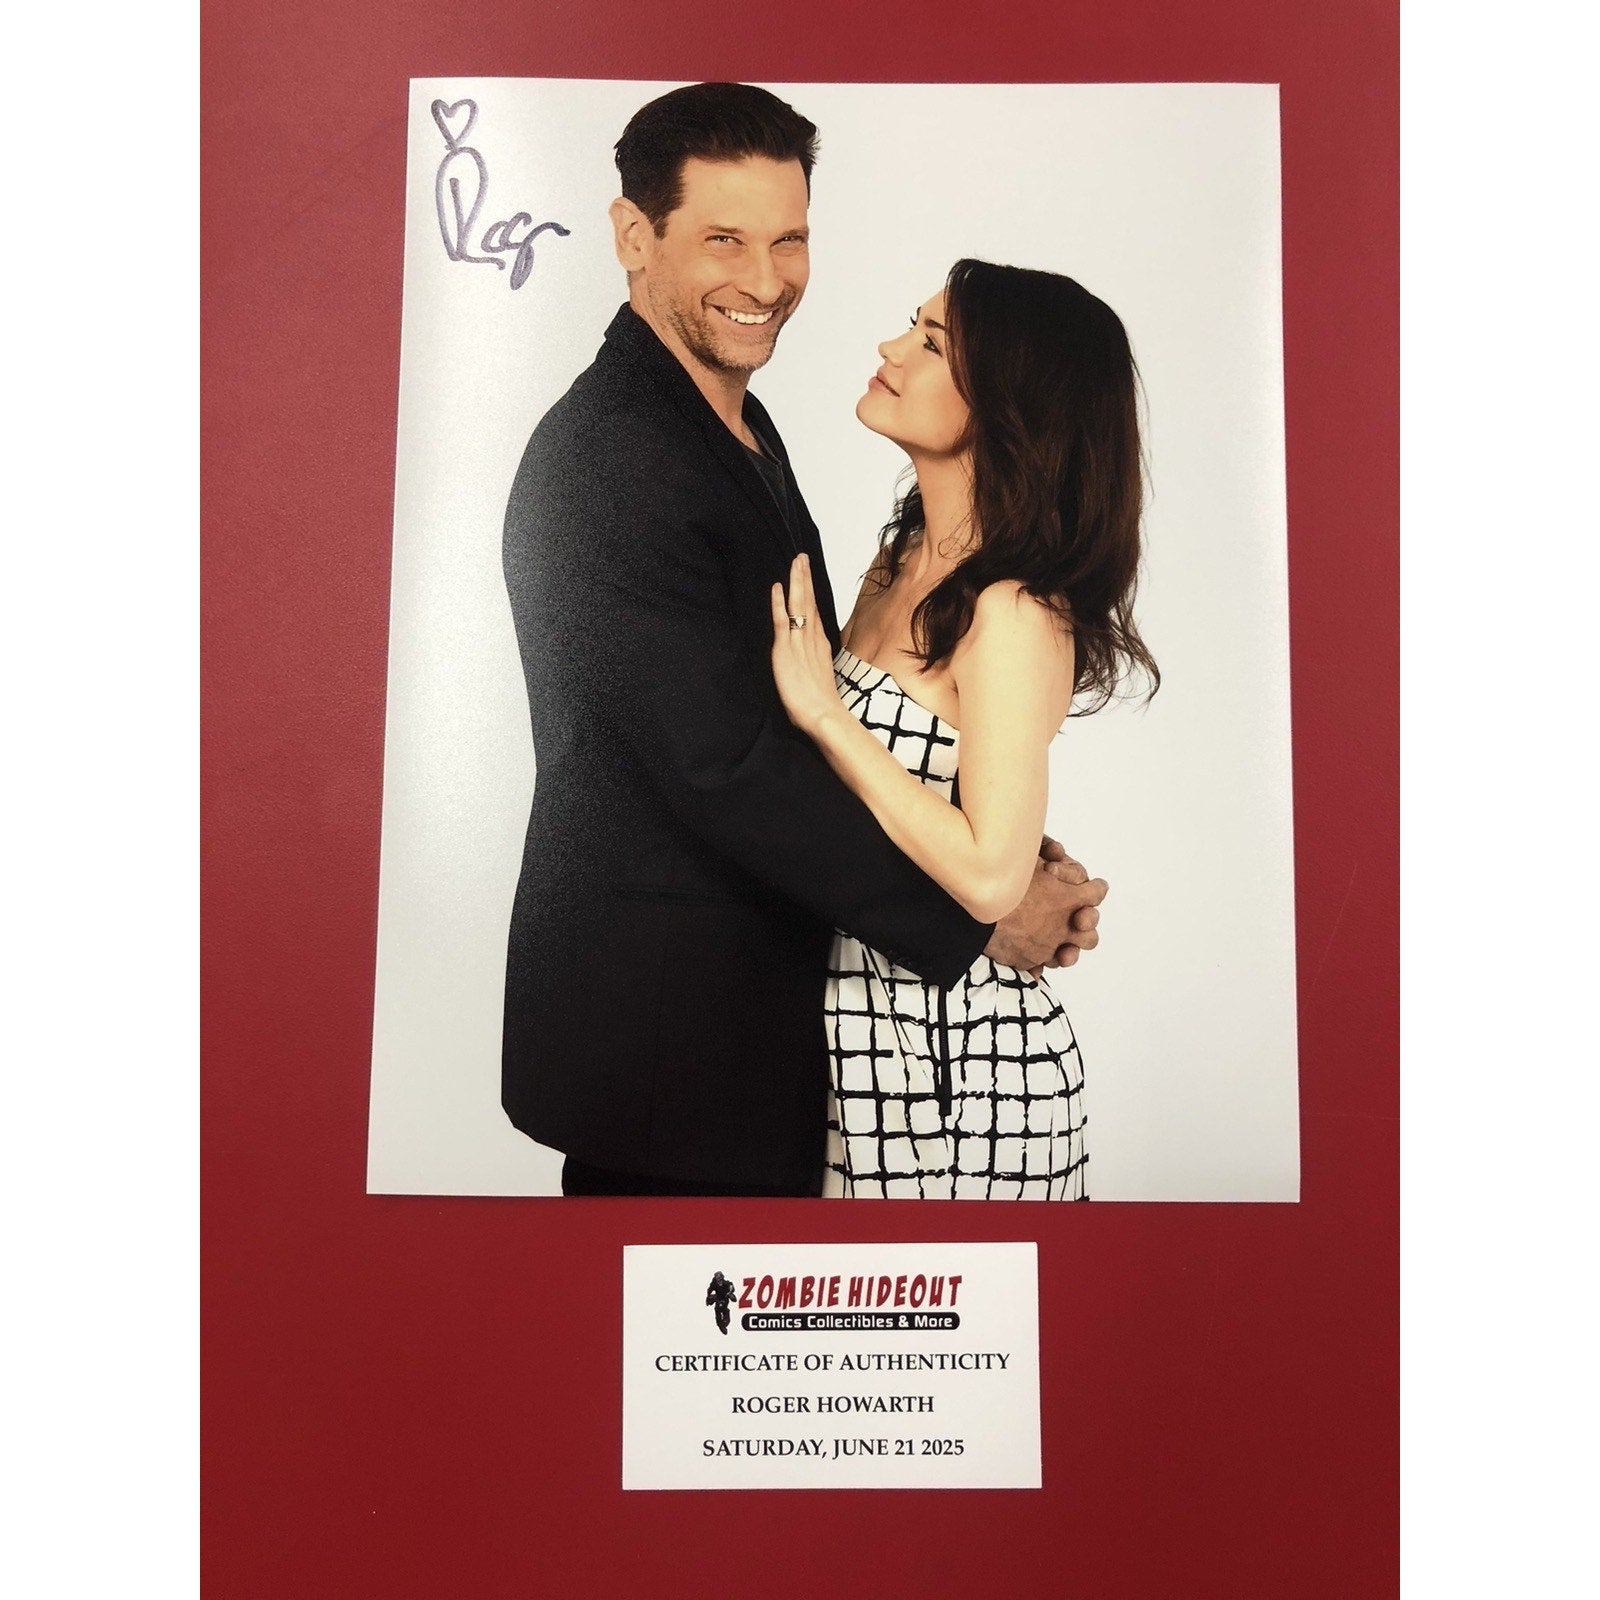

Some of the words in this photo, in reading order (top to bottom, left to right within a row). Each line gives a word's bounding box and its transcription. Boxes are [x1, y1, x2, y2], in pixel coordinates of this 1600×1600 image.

[736, 1275, 840, 1309] ZOMBIE
[847, 1274, 963, 1309] HIDEOUT
[748, 1315, 802, 1330] Comics
[807, 1314, 894, 1330] Collectibles
[898, 1315, 910, 1329] &
[914, 1315, 954, 1329] More
[655, 1354, 798, 1372] CERTIFICATE
[803, 1354, 834, 1372] OF
[838, 1352, 1010, 1371] AUTHENTICITY
[731, 1396, 811, 1414] ROGER
[816, 1395, 935, 1414] HOWARTH
[702, 1438, 828, 1460] SATURDAY,
[831, 1438, 889, 1461] JUNE
[894, 1439, 915, 1456] 21
[921, 1439, 965, 1456] 2025
